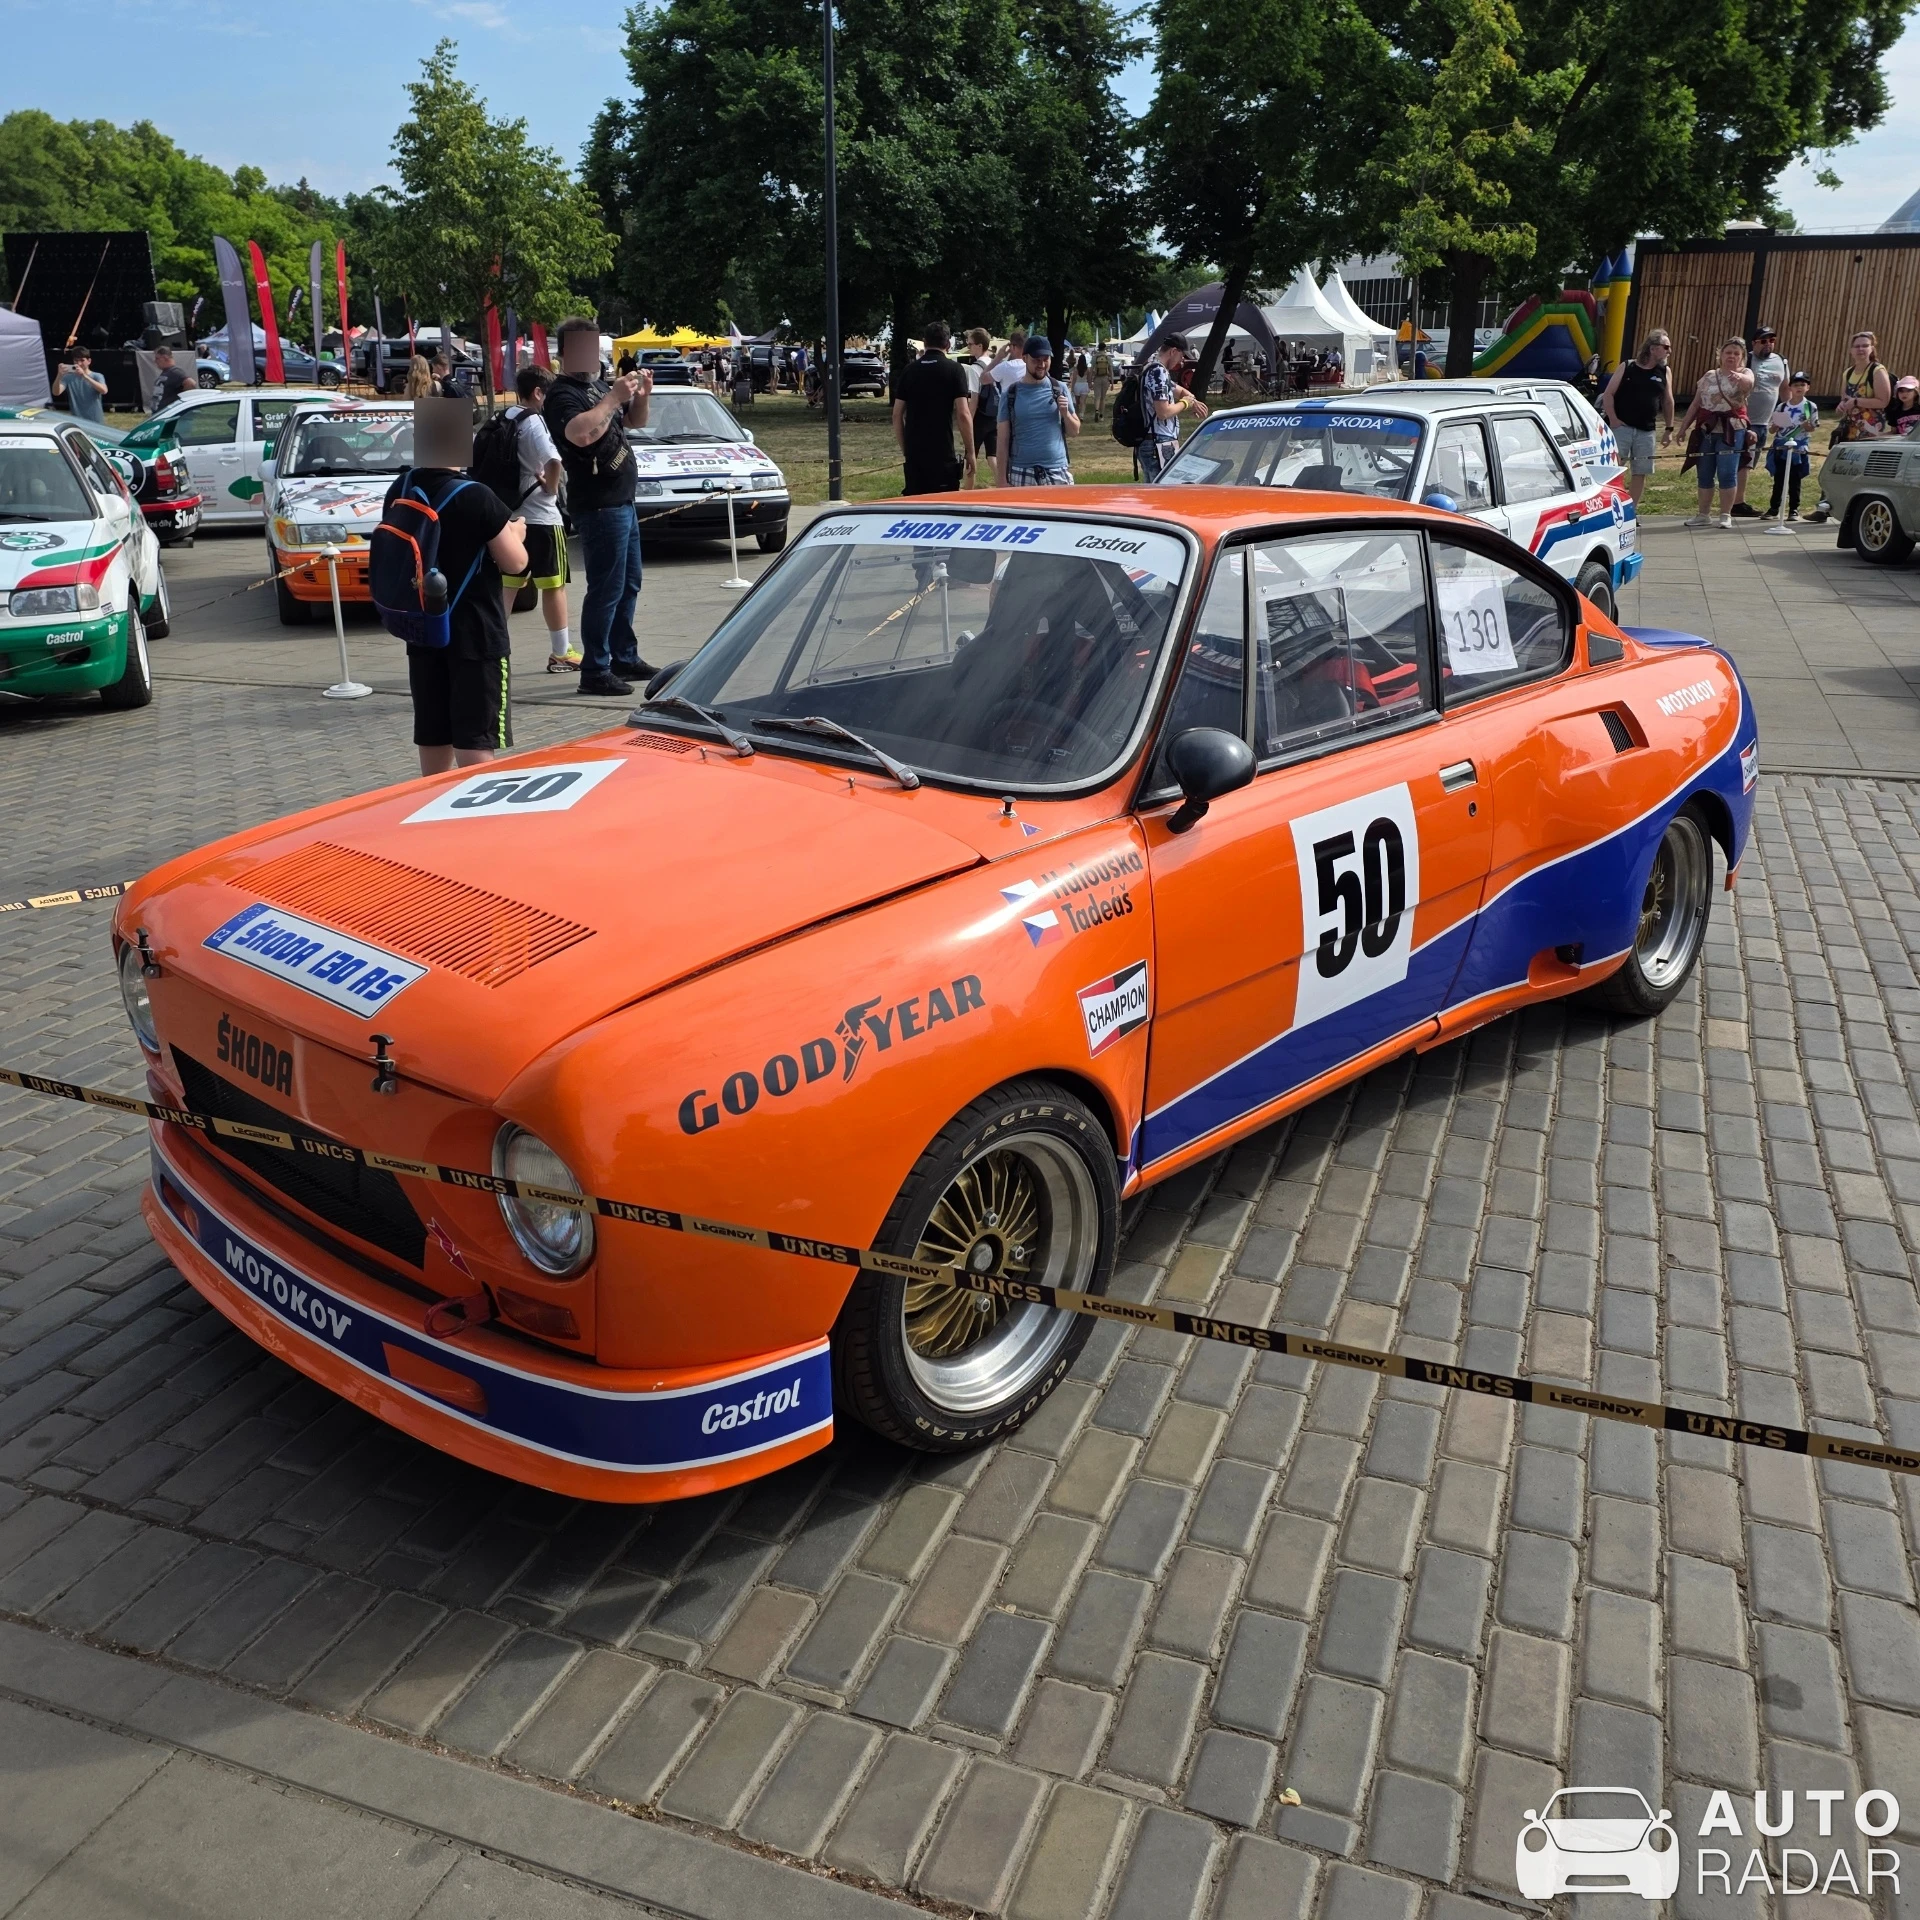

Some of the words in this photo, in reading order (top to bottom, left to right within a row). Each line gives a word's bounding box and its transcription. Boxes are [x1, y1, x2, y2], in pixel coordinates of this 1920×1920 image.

[1219, 415, 1302, 431] SURPRISING
[1328, 416, 1381, 430] SKODA
[1585, 497, 1604, 513] SACHS
[812, 523, 860, 539] Castrol
[880, 519, 962, 541] ŠKODA
[960, 523, 1003, 542] 130
[1001, 526, 1048, 545] RS
[1074, 535, 1148, 555] Castrol
[46, 630, 84, 645] Castrol
[1453, 608, 1500, 653] 130
[1655, 679, 1717, 717] MOTOKOV
[450, 771, 583, 809] 50
[1060, 883, 1134, 934] Tadeáš
[1313, 816, 1406, 979] 50
[212, 928, 232, 942] CZ
[233, 919, 325, 968] ŠKODA
[306, 950, 369, 985] 130
[346, 966, 408, 1002] RS
[1088, 983, 1145, 1034] CHAMPION
[216, 1011, 294, 1098] ŠKODA
[677, 974, 987, 1136] GOODYEAR
[962, 1106, 1055, 1160] EAGLE
[1063, 1113, 1088, 1131] F1
[29, 1077, 76, 1099] UNCS
[155, 1106, 206, 1129] UNCS
[301, 1139, 356, 1162] UNCS
[449, 1170, 507, 1194] UNCS
[609, 1203, 671, 1228] UNCS
[781, 1237, 848, 1263] UNCS
[968, 1273, 1041, 1303] UNCS
[1190, 1317, 1272, 1350] UNCS
[1424, 1363, 1515, 1397] UNCS
[1686, 1414, 1788, 1449] UNCS
[1827, 1443, 1920, 1468] LEGEND
[225, 1237, 352, 1340] MOTOKOV
[701, 1377, 801, 1435] Castrol
